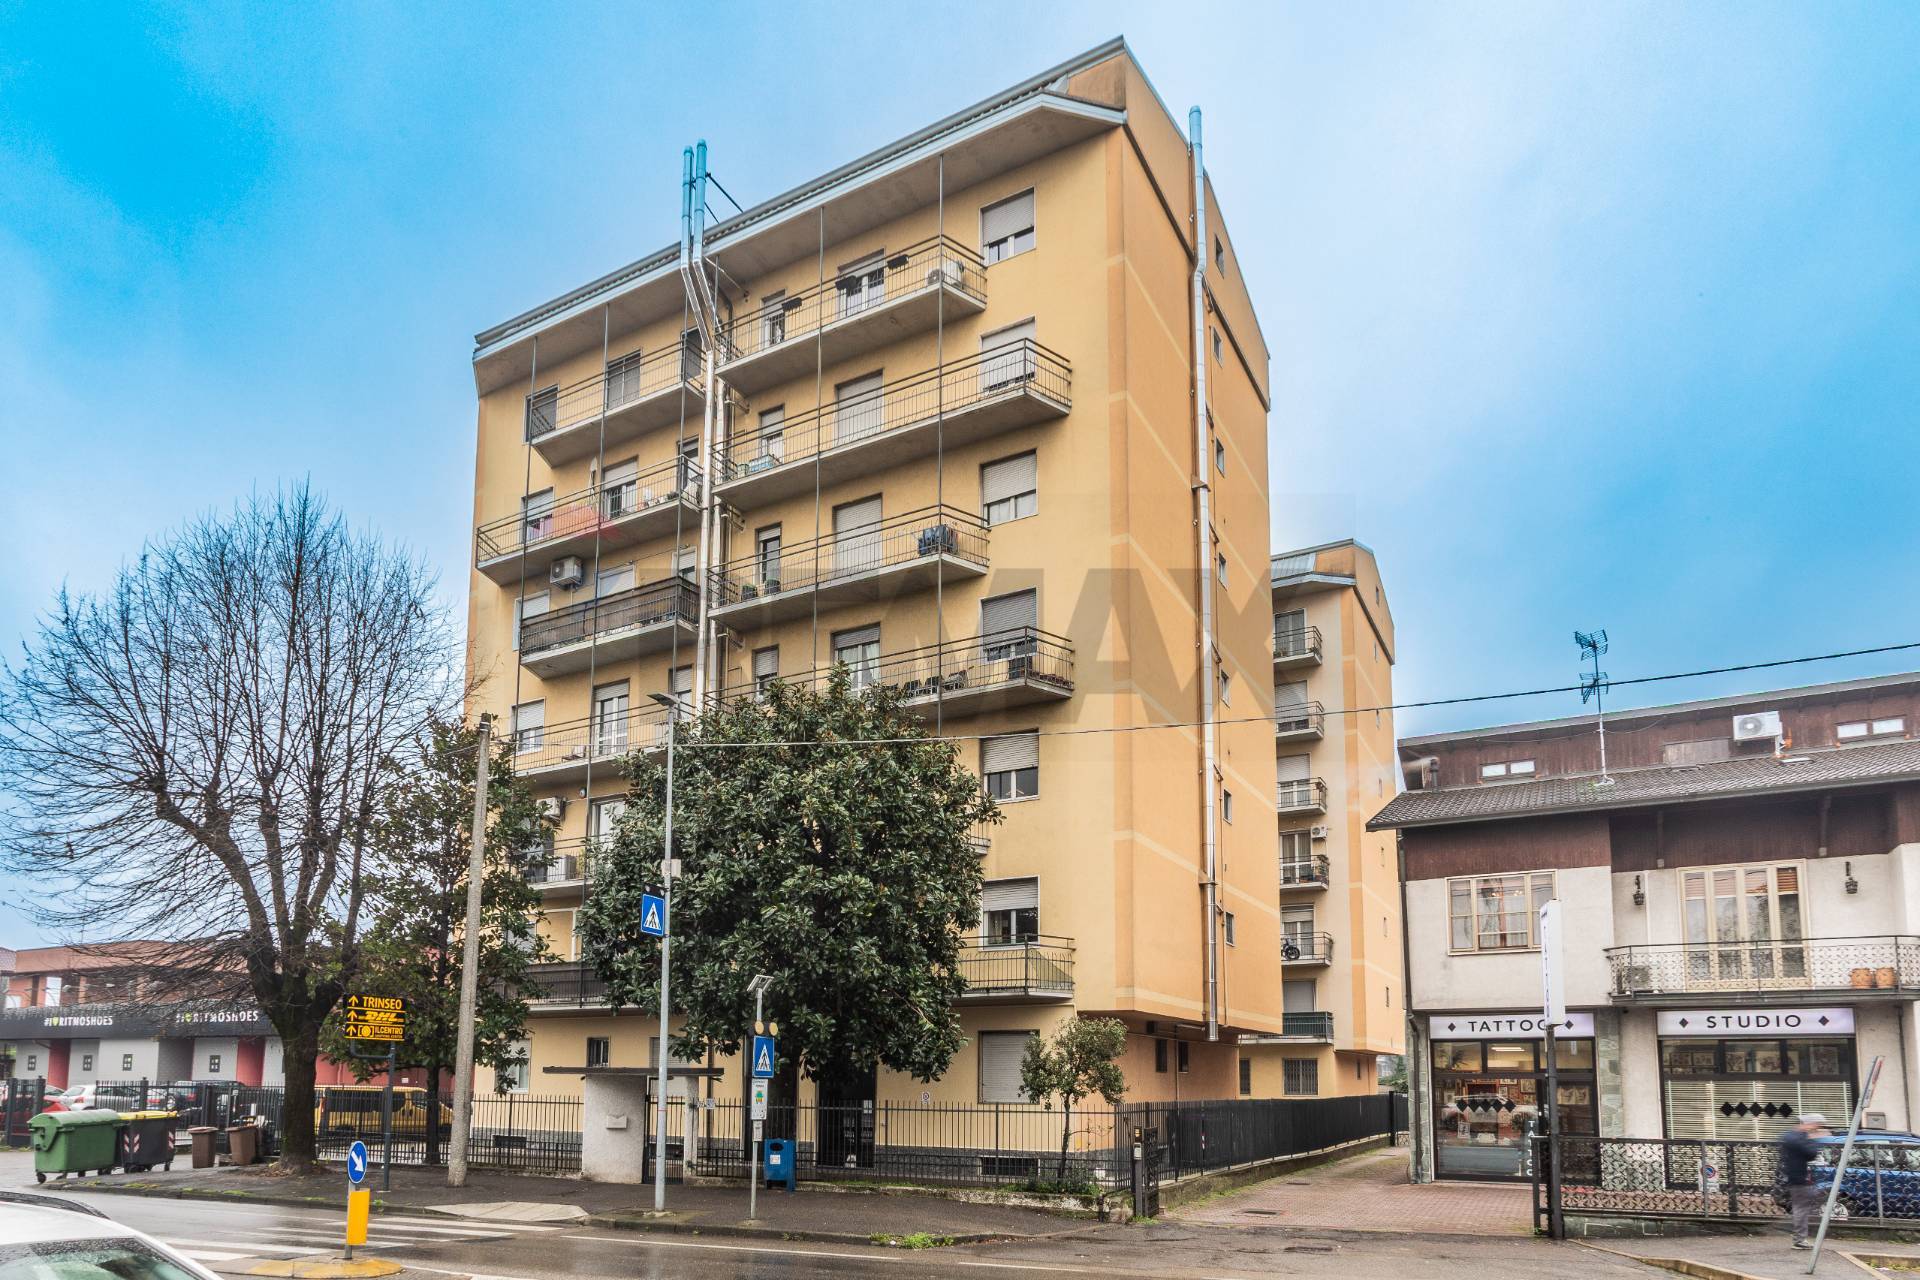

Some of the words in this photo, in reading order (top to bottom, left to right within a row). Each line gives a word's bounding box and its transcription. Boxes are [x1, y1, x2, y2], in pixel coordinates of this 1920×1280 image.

[363, 997, 402, 1010] TRINSEO
[365, 1011, 397, 1021] DHL
[1706, 1014, 1802, 1029] STUDIO
